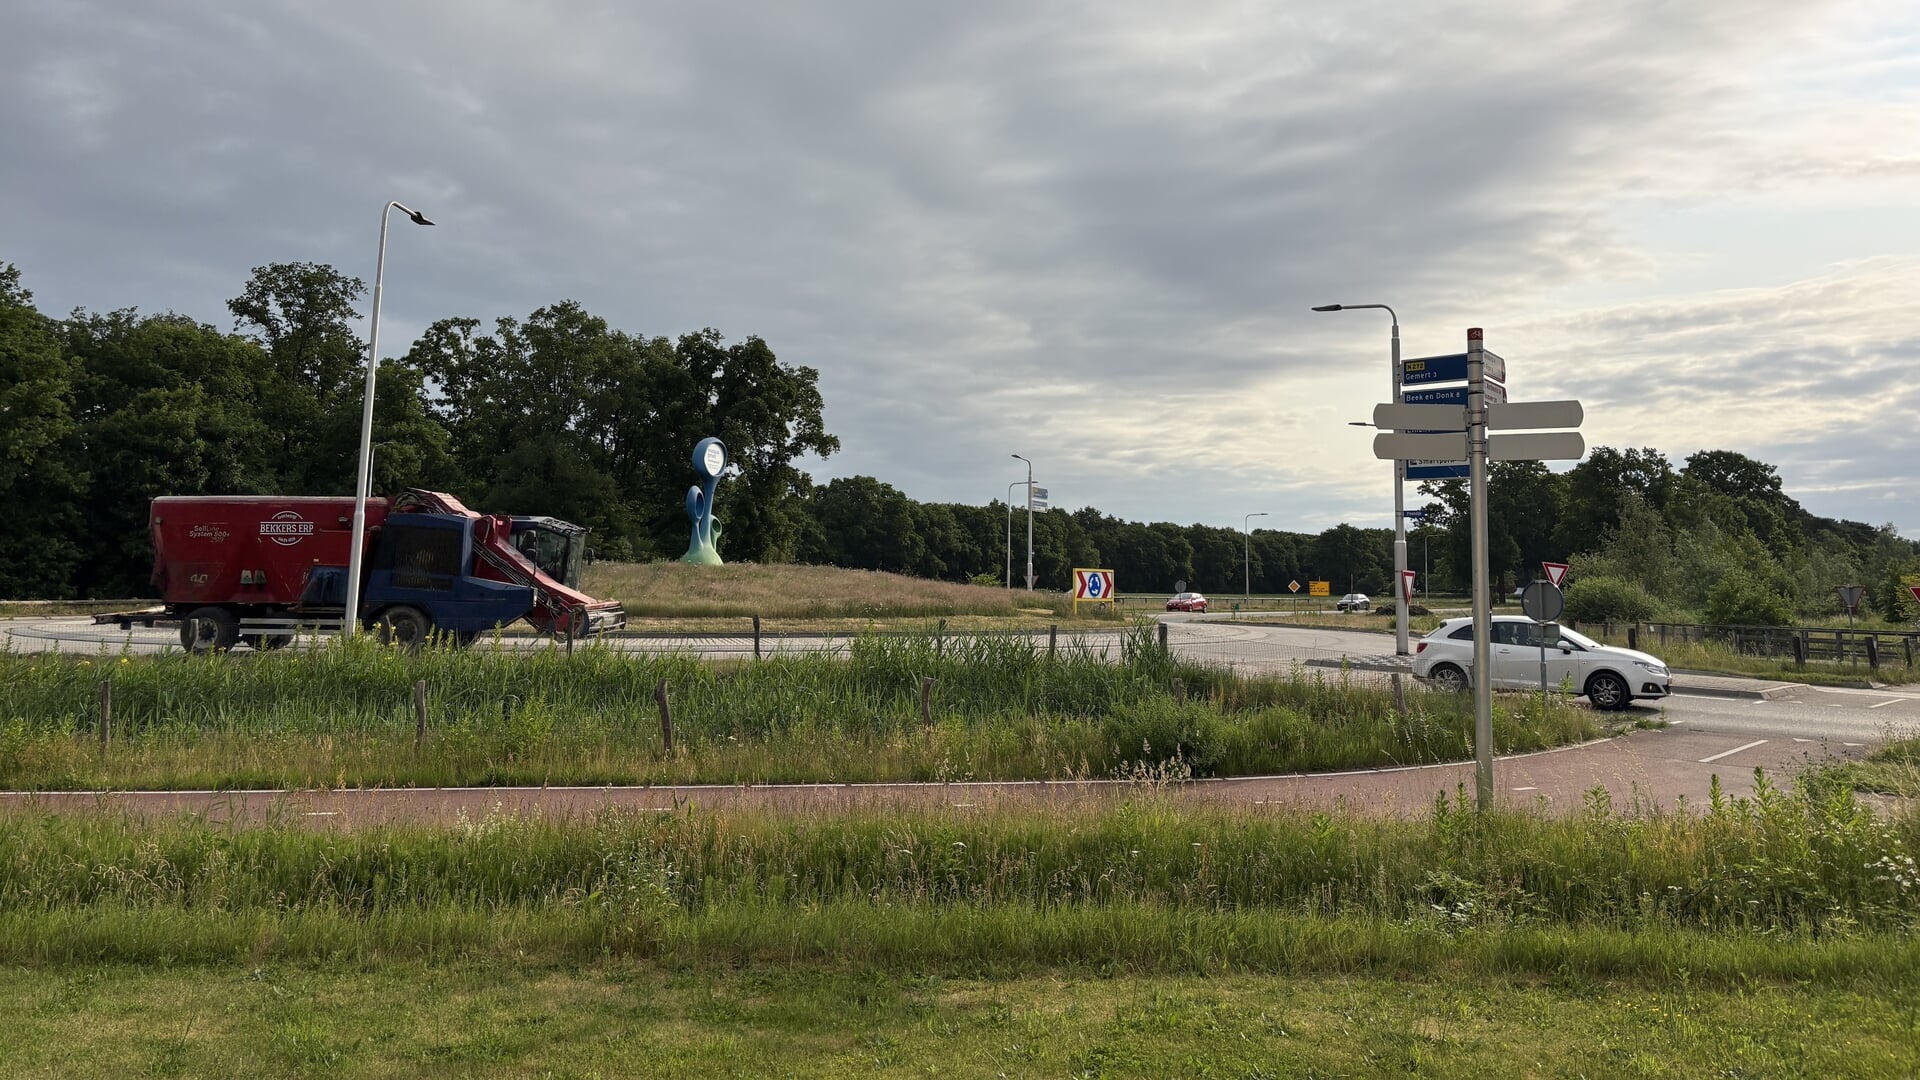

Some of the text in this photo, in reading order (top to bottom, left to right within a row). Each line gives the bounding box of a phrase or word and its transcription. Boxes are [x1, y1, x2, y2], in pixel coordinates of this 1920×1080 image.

[1405, 372, 1431, 380] Gemert
[1406, 394, 1424, 402] Beek
[1436, 391, 1454, 399] Donk
[260, 524, 314, 533] BEKKERS ERP
[189, 530, 213, 538] System
